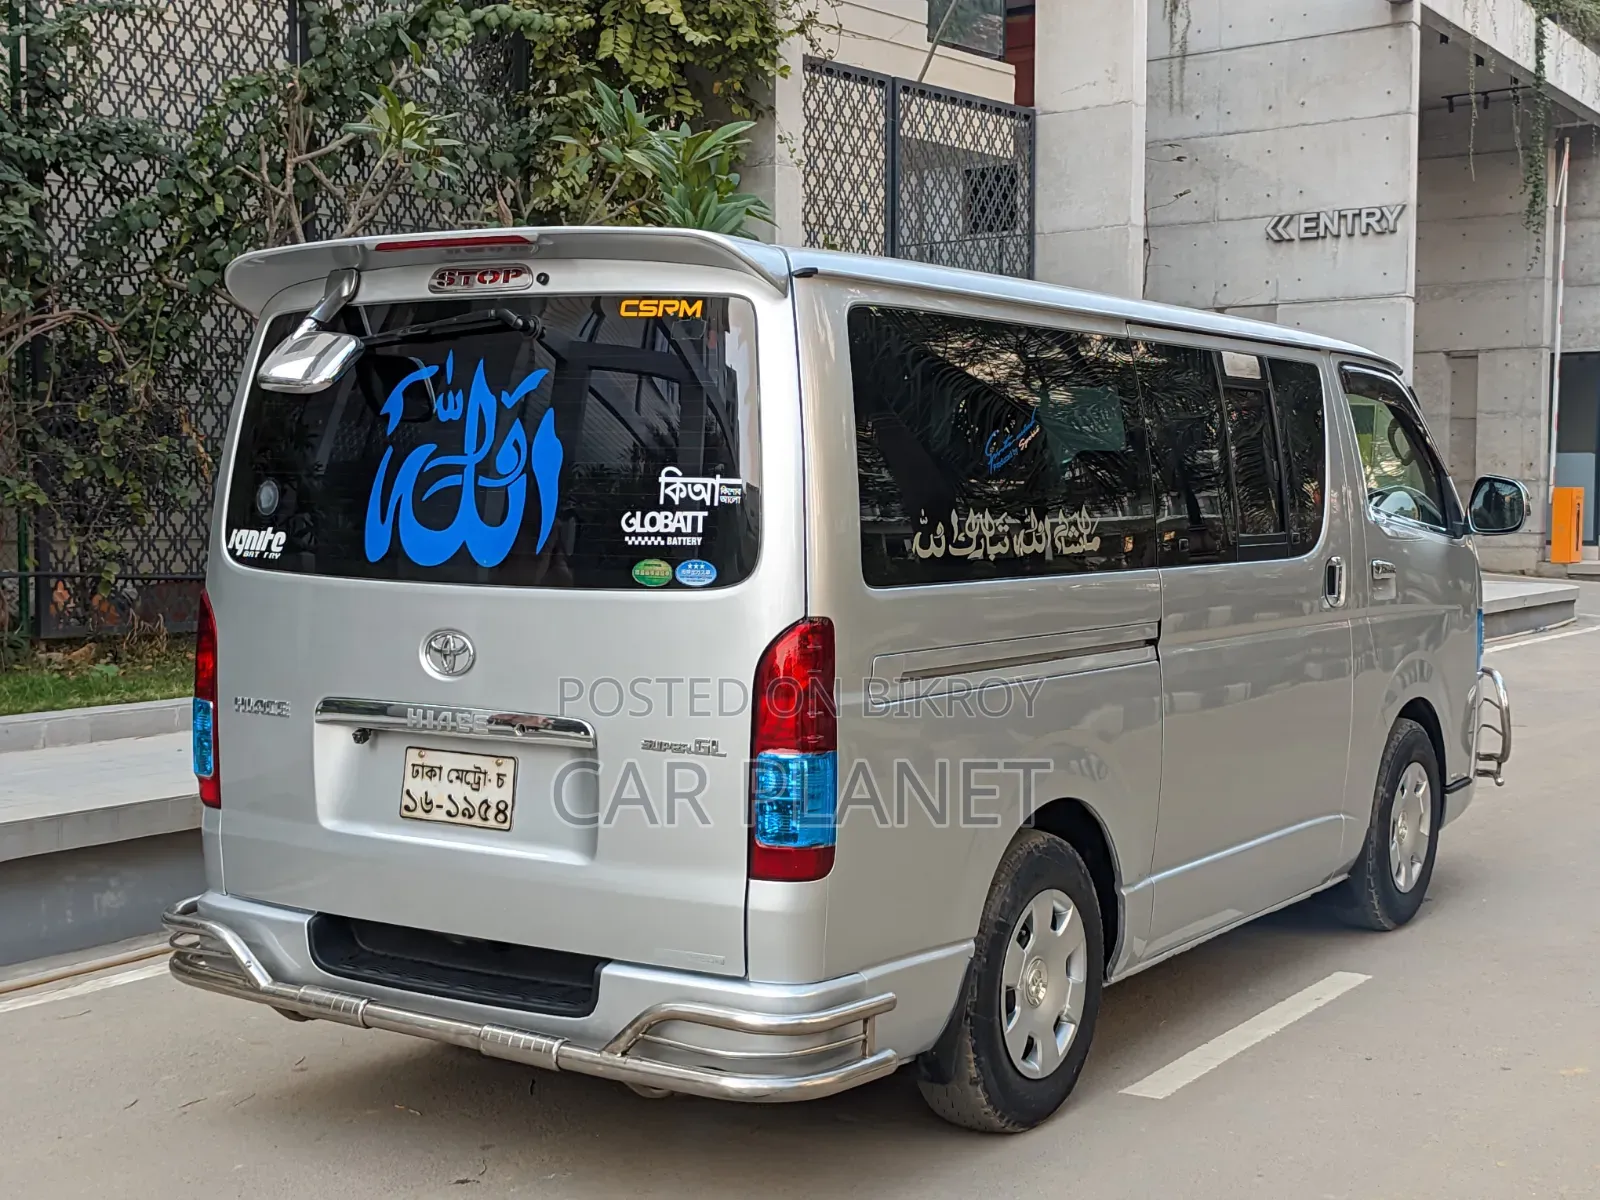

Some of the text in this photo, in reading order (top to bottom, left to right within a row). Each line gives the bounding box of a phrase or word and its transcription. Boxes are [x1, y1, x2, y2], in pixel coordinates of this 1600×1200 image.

[1299, 202, 1407, 240] ENTRY
[436, 268, 523, 287] STOP
[619, 300, 703, 317] CSRM
[621, 511, 708, 533] GLOBATT
[666, 536, 702, 545] BATTERY
[411, 763, 443, 782] ঢাকা
[404, 788, 509, 825] ১৬-১৯৫৪
